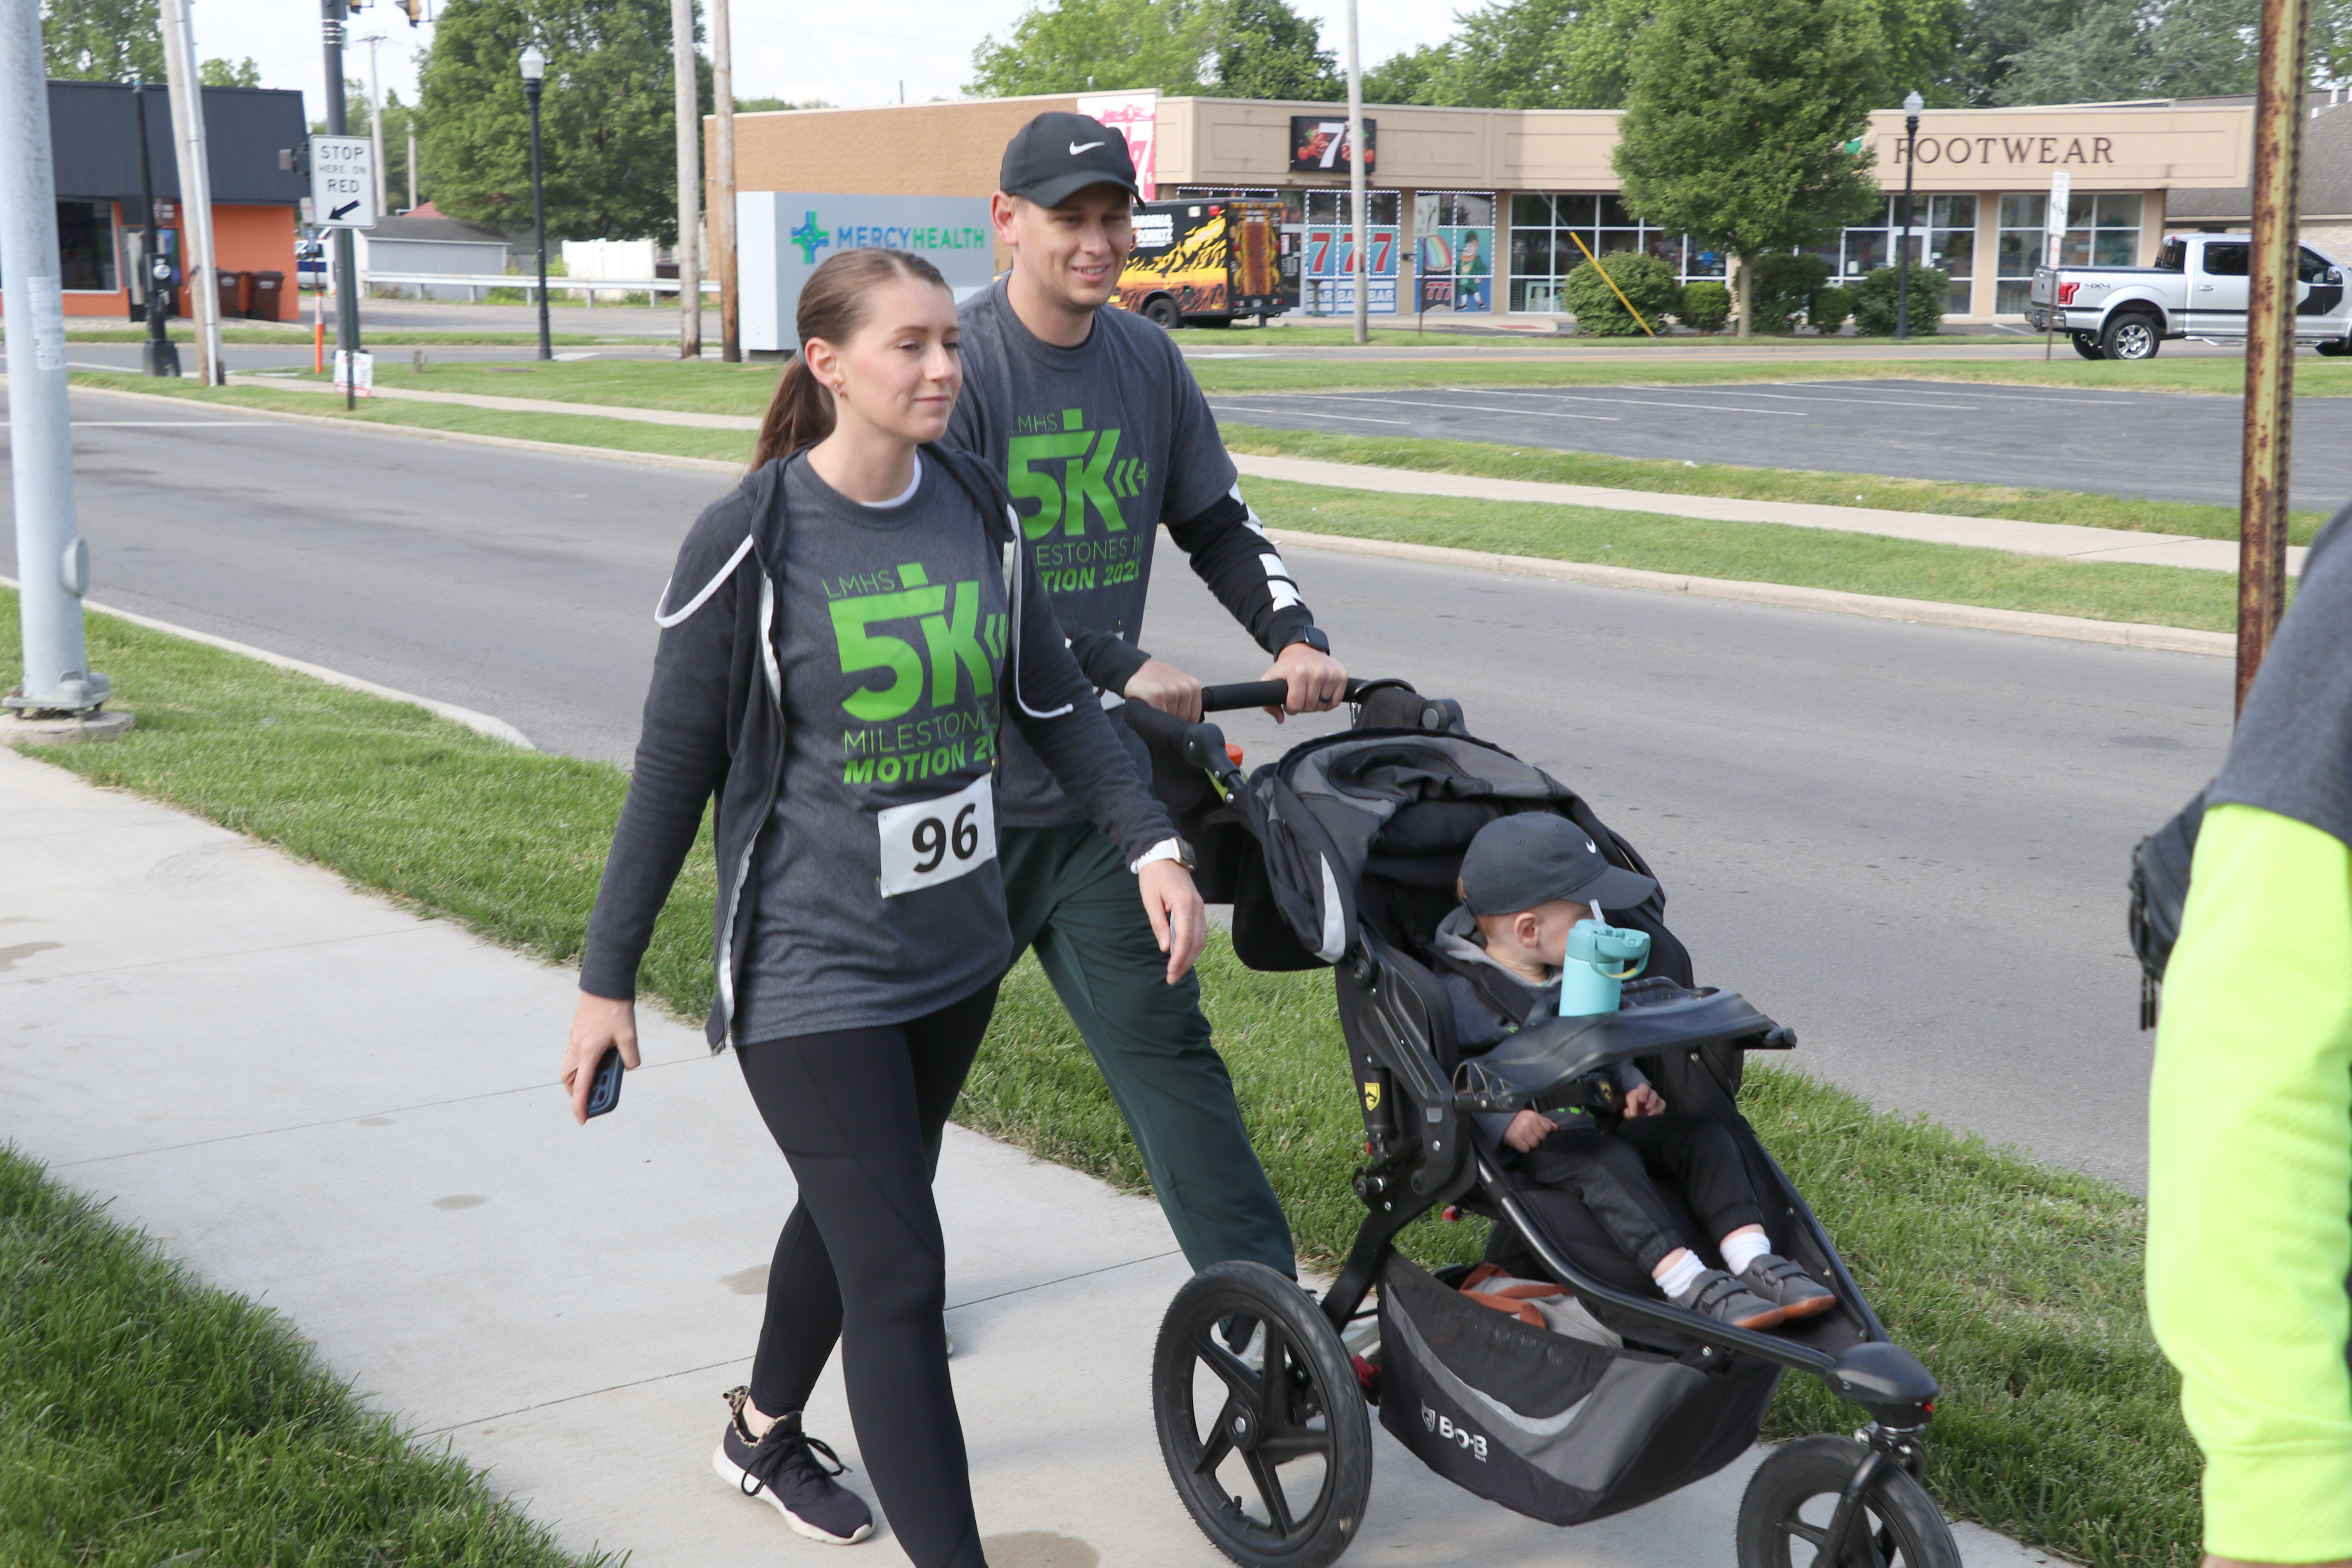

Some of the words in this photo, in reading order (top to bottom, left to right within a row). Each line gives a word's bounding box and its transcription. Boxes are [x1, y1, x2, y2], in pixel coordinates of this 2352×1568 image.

[320, 145, 364, 160] STOP
[1318, 122, 1345, 168] 7
[1893, 137, 2114, 164] FOOTWEAR
[319, 165, 346, 174] HERE
[352, 166, 367, 175] ON
[327, 178, 359, 193] RED
[1338, 290, 1355, 303] BA
[1368, 290, 1394, 303] BAR
[1007, 428, 1127, 542] 5K
[1036, 537, 1127, 567] ESTONES
[822, 570, 895, 599] LMHS
[1039, 566, 1096, 593] TION
[828, 580, 993, 722] 5K
[844, 739, 965, 784] MOTION
[912, 802, 978, 873] 96
